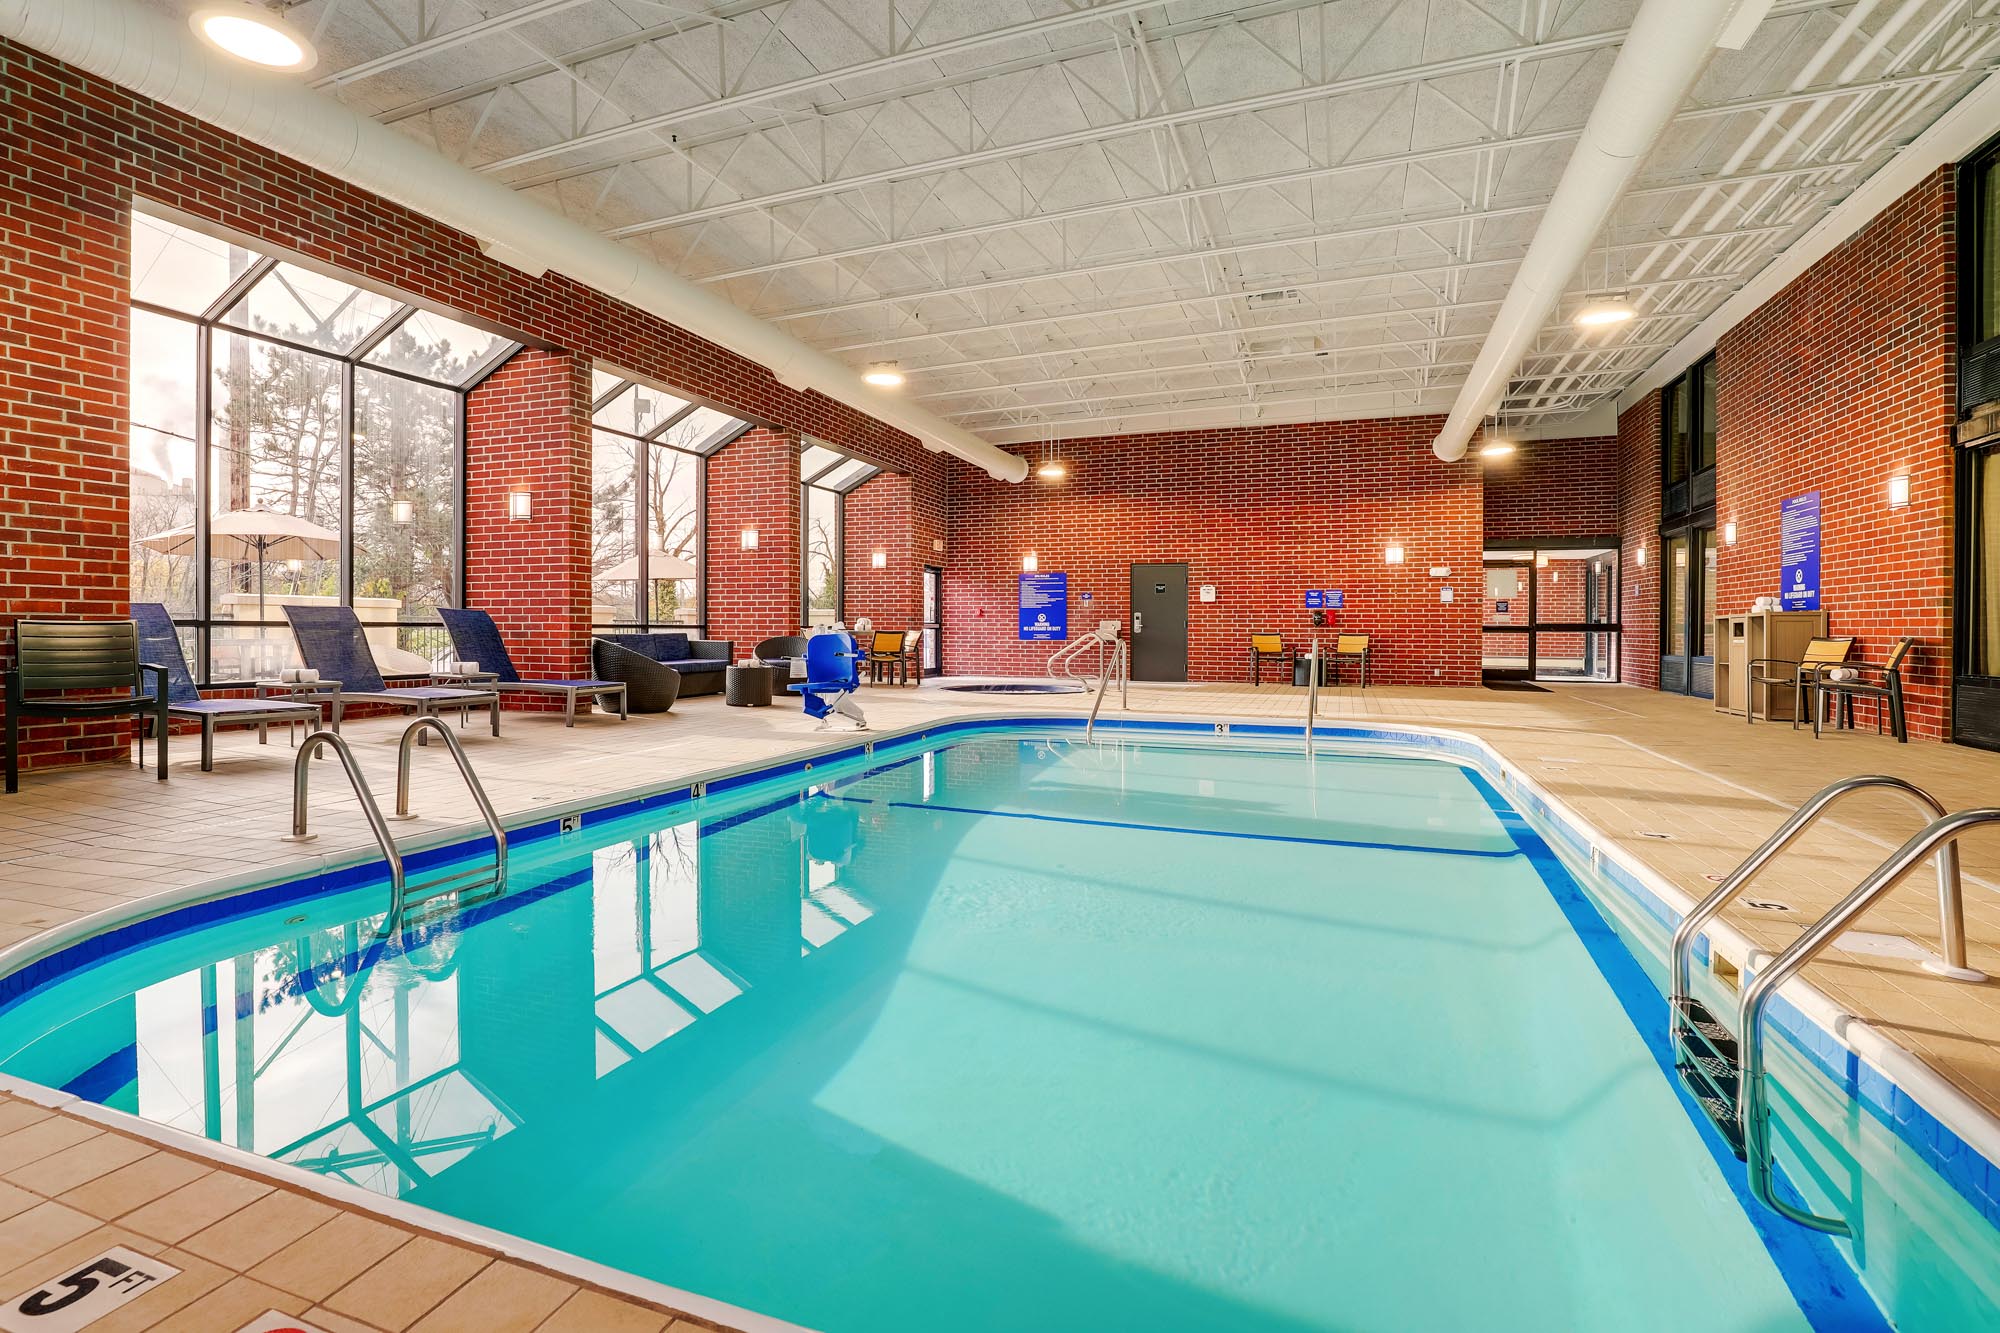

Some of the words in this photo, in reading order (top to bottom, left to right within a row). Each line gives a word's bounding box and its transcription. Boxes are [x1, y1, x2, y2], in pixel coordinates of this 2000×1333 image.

[693, 783, 700, 797] 4
[562, 818, 573, 832] 5
[573, 815, 579, 824] FT
[18, 1257, 132, 1316] 5
[108, 1270, 157, 1295] FT
